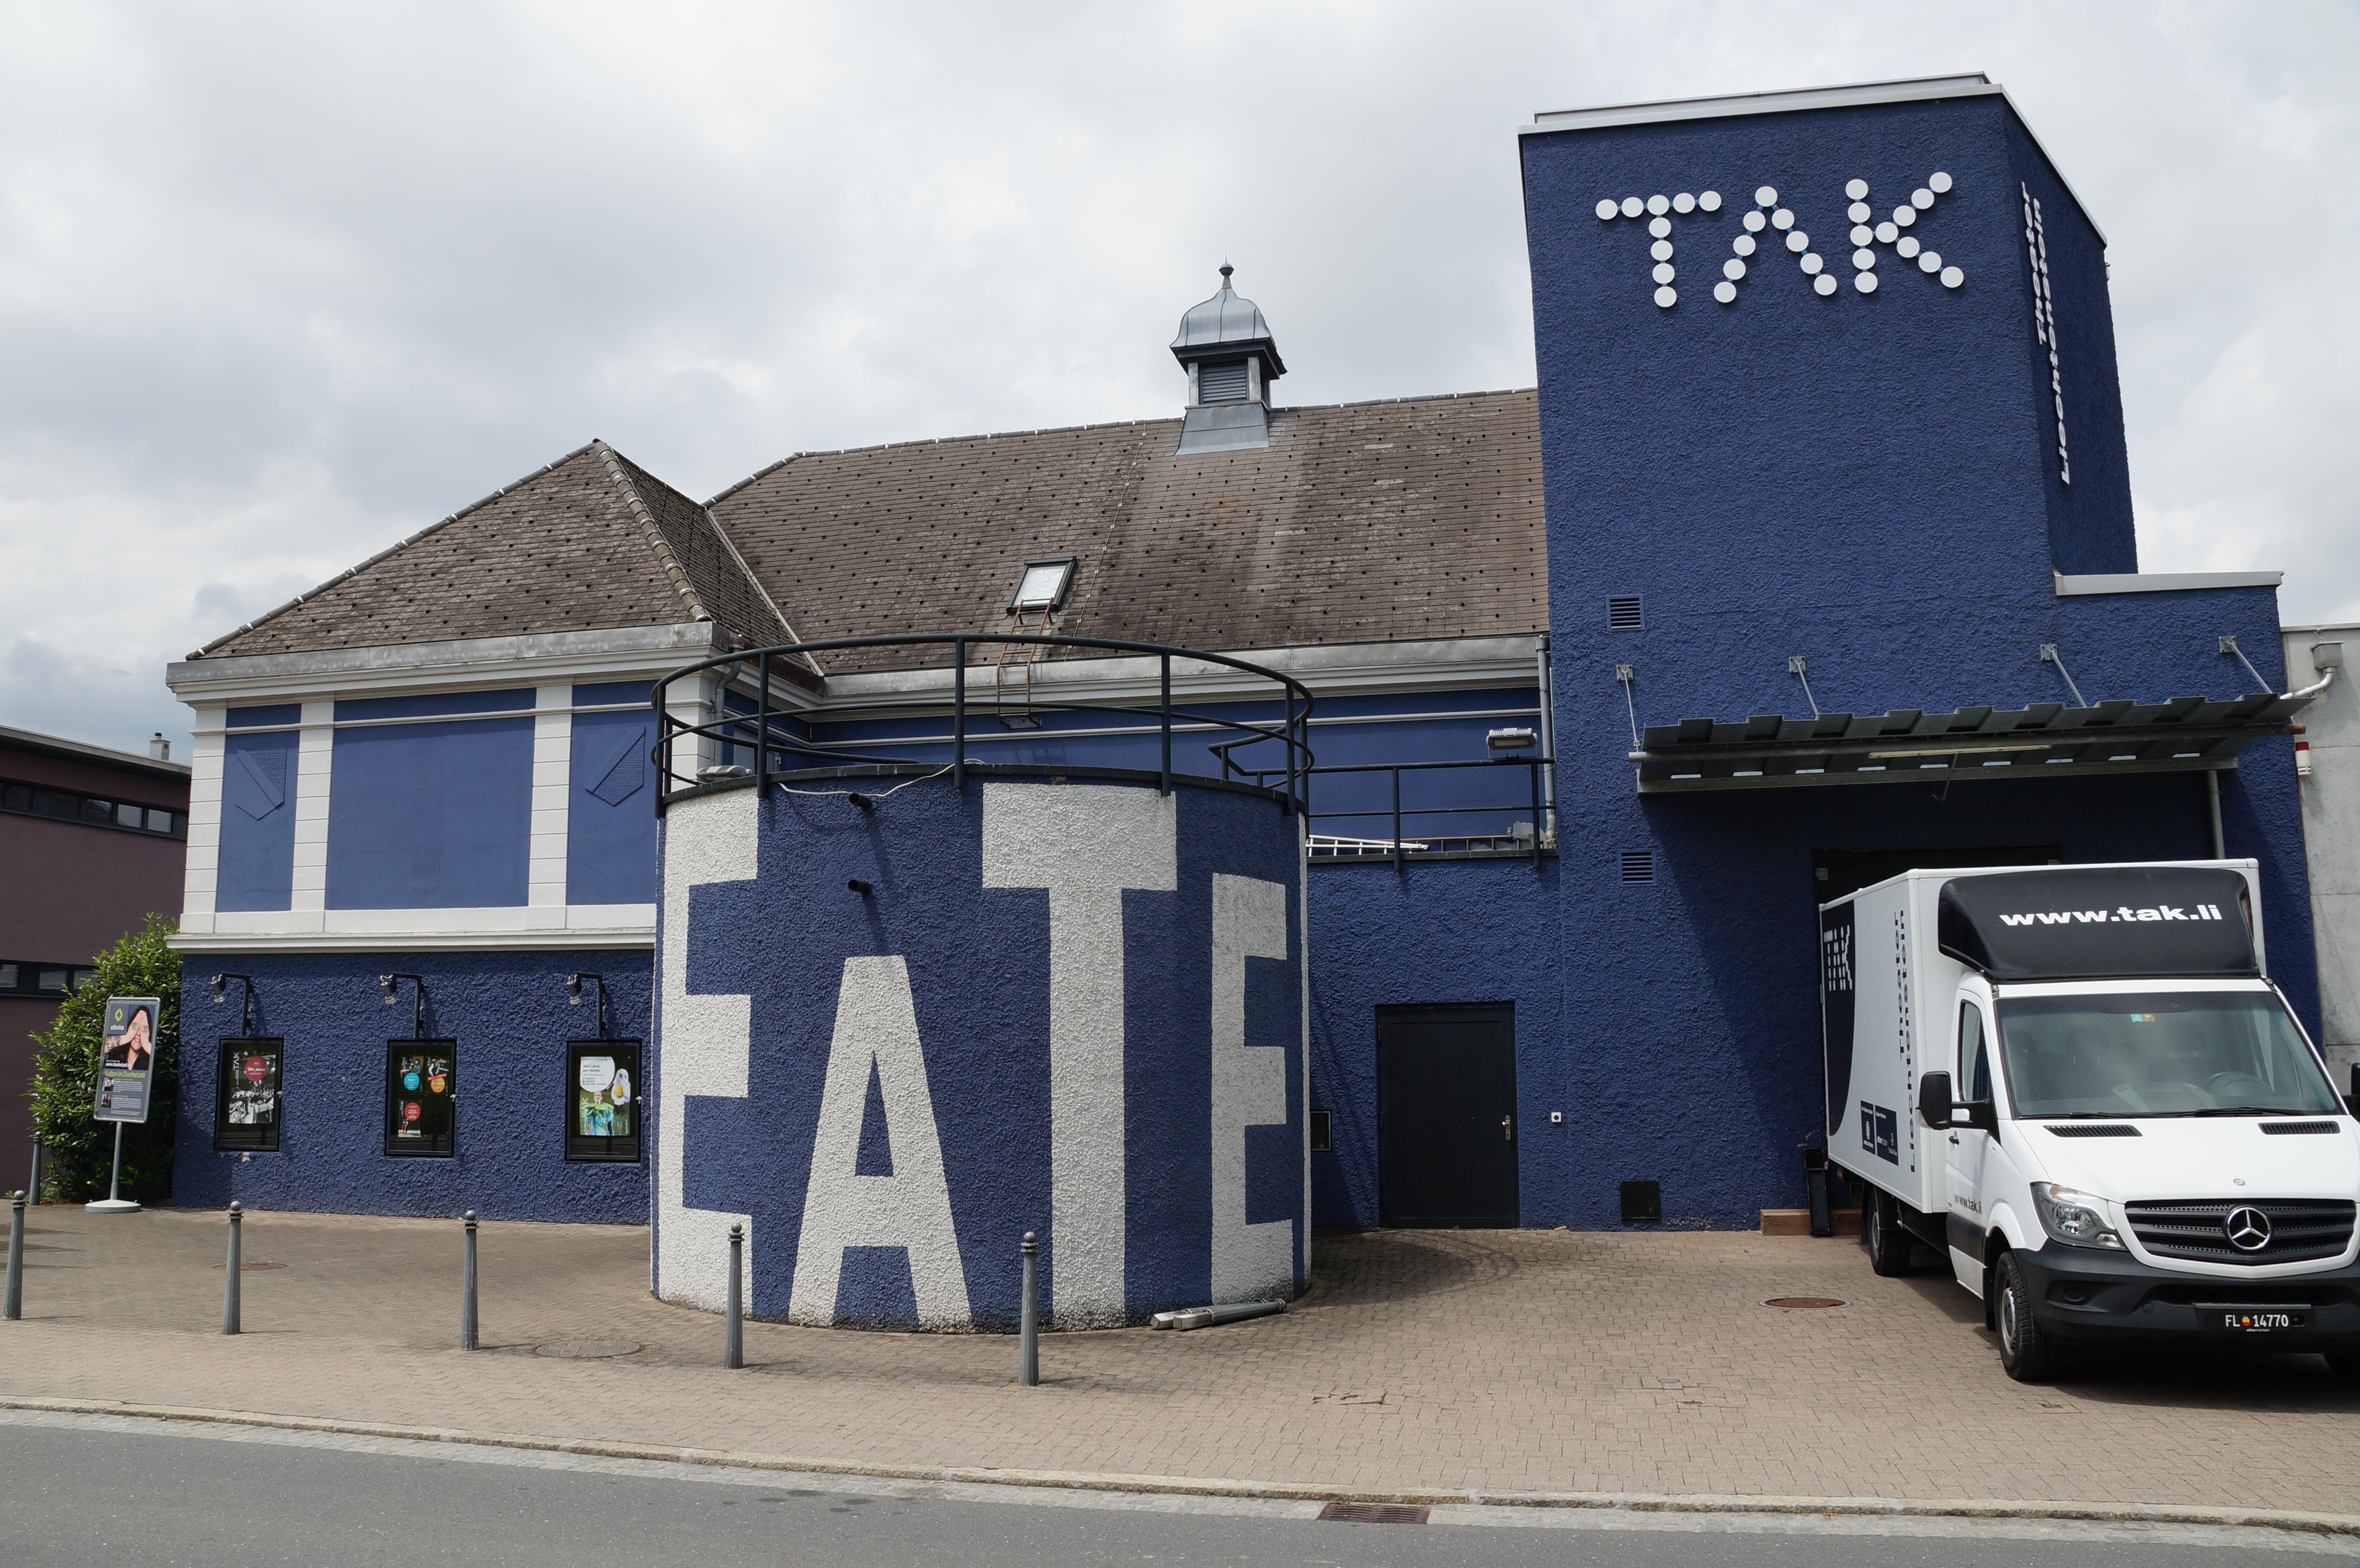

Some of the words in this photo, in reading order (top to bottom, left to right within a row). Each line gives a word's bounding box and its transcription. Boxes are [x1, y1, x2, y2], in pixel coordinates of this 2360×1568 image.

[1595, 172, 1964, 308] TAK
[2021, 181, 2047, 345] Theater
[2033, 197, 2070, 485] Liechtenstein
[1824, 924, 1853, 992] TAK
[1894, 911, 1905, 1061] Theater
[1999, 904, 2223, 926] www.tak.li
[656, 782, 1312, 1335] EATE
[1900, 910, 1915, 1173] Liechtenstein
[1954, 1193, 1982, 1214] www.tak.li
[2225, 1314, 2240, 1327] FL
[2252, 1314, 2289, 1327] 14770
